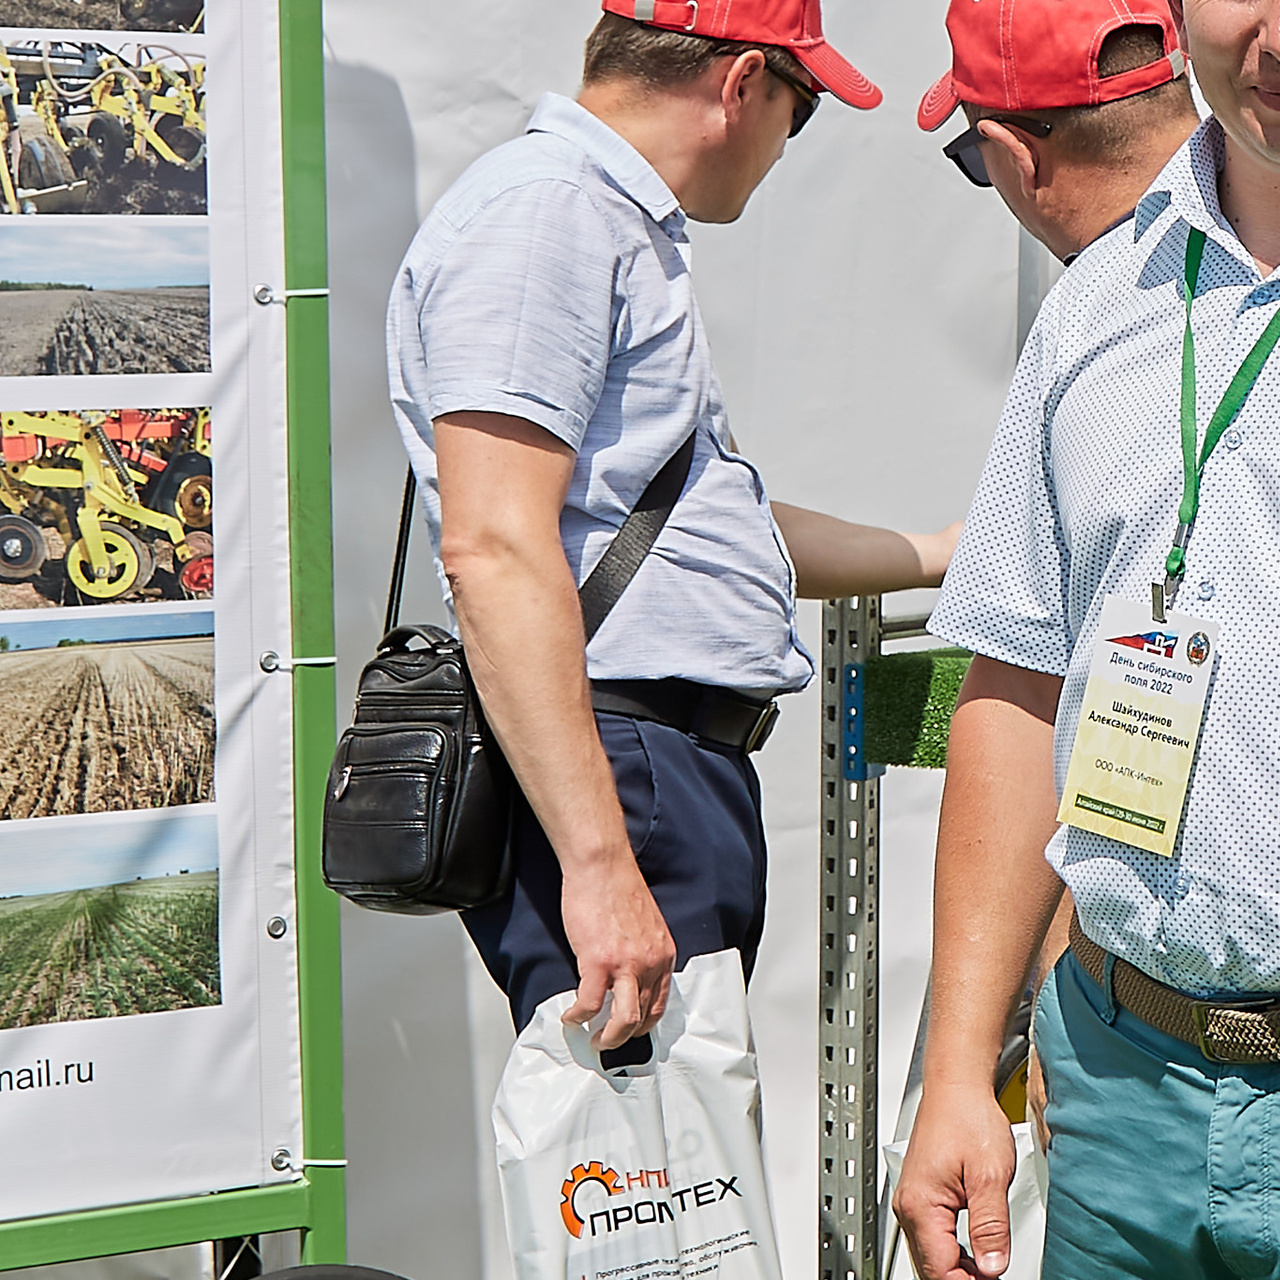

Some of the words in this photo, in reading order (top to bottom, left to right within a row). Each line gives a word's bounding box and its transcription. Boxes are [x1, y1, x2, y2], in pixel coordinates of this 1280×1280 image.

[1109, 651, 1135, 668] День
[1137, 660, 1193, 684] сибирского
[1124, 673, 1148, 688] поля
[1149, 678, 1174, 695] 2022
[1111, 700, 1173, 728] Шайхудинов
[1087, 710, 1139, 737] Александр
[1140, 725, 1190, 749] Сергеевич
[1095, 758, 1114, 773] ООО
